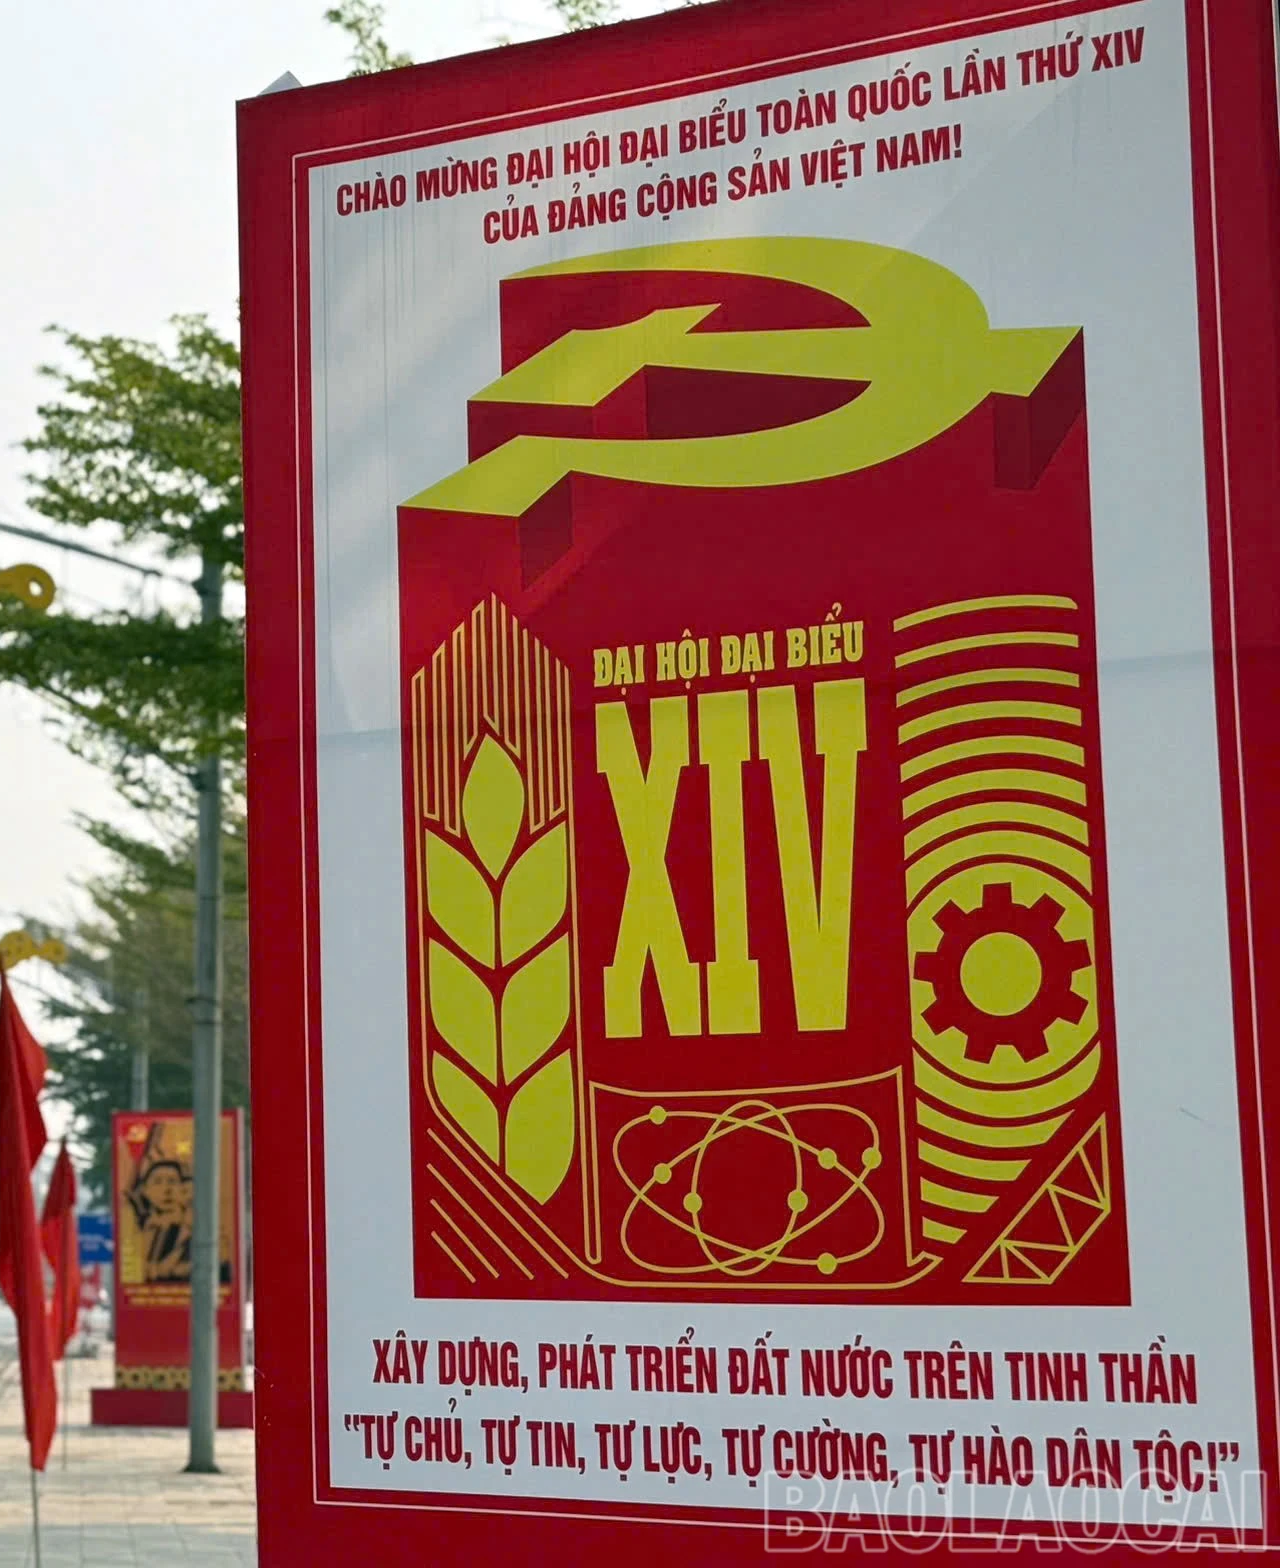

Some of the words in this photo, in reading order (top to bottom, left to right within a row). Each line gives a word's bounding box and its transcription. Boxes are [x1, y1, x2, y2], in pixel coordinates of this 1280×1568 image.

[336, 173, 407, 216] CHÀO
[417, 155, 498, 202] MỪNG
[506, 147, 554, 189] ĐẠI
[563, 130, 610, 178] HỘI
[620, 124, 669, 168] ĐẠI
[680, 98, 747, 153] BIỂU
[757, 88, 837, 137] TOÀN
[848, 62, 933, 122] QUỐC
[944, 48, 1007, 101] LẦN
[1017, 31, 1083, 85] THỨ
[1092, 26, 1145, 72] XIV
[483, 194, 540, 244] CỦA
[547, 182, 627, 231] ĐẢNG
[637, 171, 717, 221] CỘNG
[727, 147, 791, 201] SẢN
[801, 139, 866, 188] VIỆT
[876, 124, 963, 173] NAM!
[593, 645, 646, 696] ĐẠI
[656, 628, 710, 690] HỘI
[721, 631, 775, 683] ĐẠI
[786, 602, 864, 669] BIỂU
[595, 677, 868, 1039] XIV
[372, 1329, 428, 1384] XÂY
[437, 1336, 529, 1396] DỰNG,
[538, 1333, 616, 1390] PHÁT
[625, 1326, 718, 1394] TRIỂN
[727, 1331, 790, 1396] ĐẤT
[801, 1334, 894, 1399] NƯỚC
[904, 1340, 995, 1401] TRÊN
[1005, 1352, 1089, 1402] TINH
[1099, 1335, 1198, 1405] THẦN
[404, 1397, 473, 1470] CHỦ,
[480, 1415, 521, 1476] TỰ
[526, 1421, 586, 1475] TIN,
[594, 1419, 637, 1481] TỰ
[643, 1421, 713, 1484] LỰC,
[721, 1424, 766, 1488] TỰ
[773, 1417, 900, 1489] CƯỜNG,
[909, 1430, 956, 1495] TỰ
[963, 1425, 1034, 1487] HÀO
[1046, 1427, 1123, 1490] DÂN
